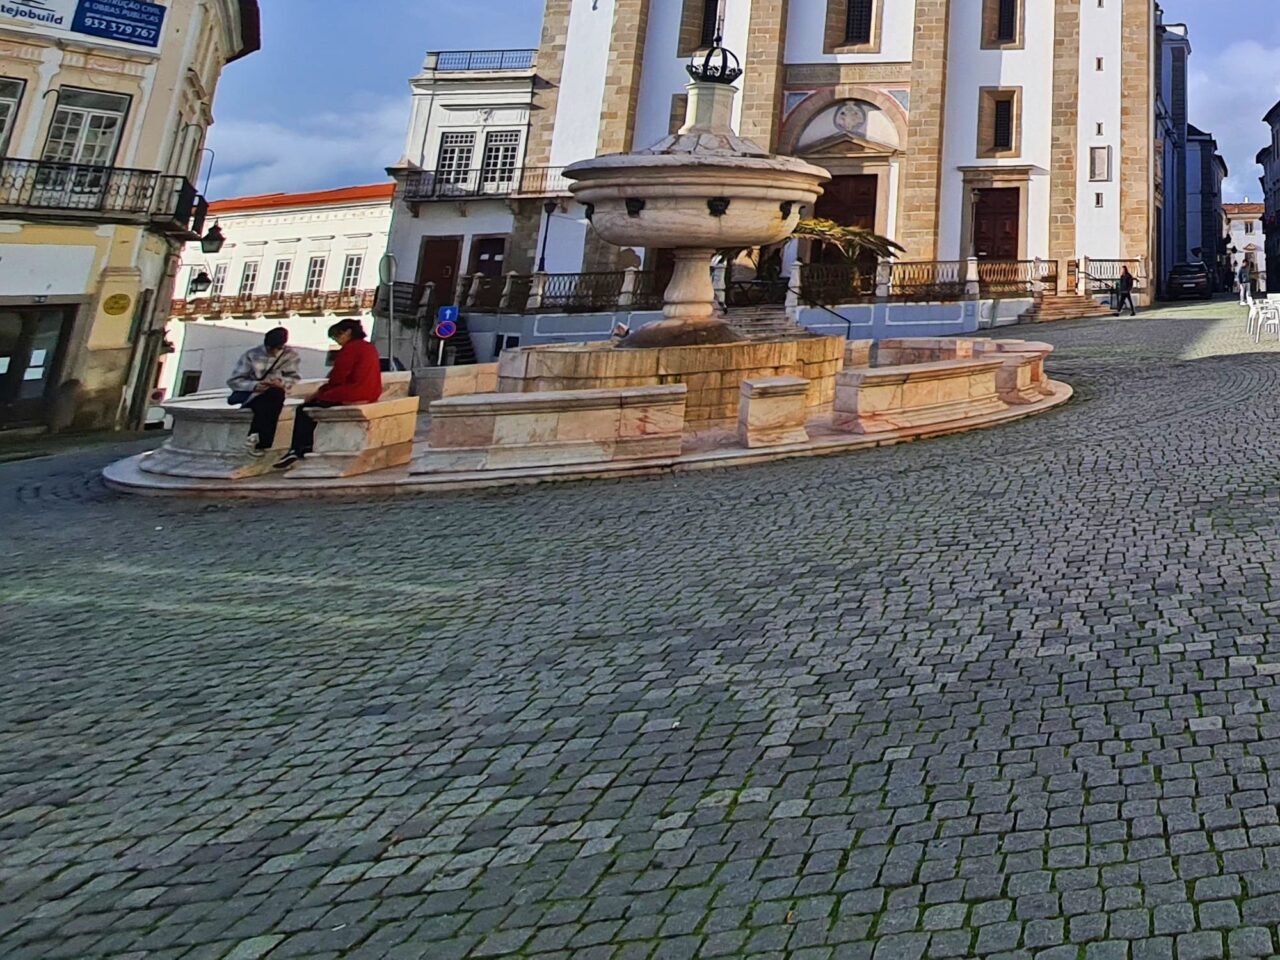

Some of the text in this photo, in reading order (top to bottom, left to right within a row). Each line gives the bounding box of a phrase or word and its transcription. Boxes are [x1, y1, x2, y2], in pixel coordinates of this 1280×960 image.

[1, 4, 64, 25] tejobuild
[92, 2, 120, 15] OBRAS
[141, 5, 160, 15] CIVIL
[84, 17, 107, 29] 932
[109, 22, 133, 34] 379
[135, 27, 156, 39] 767
